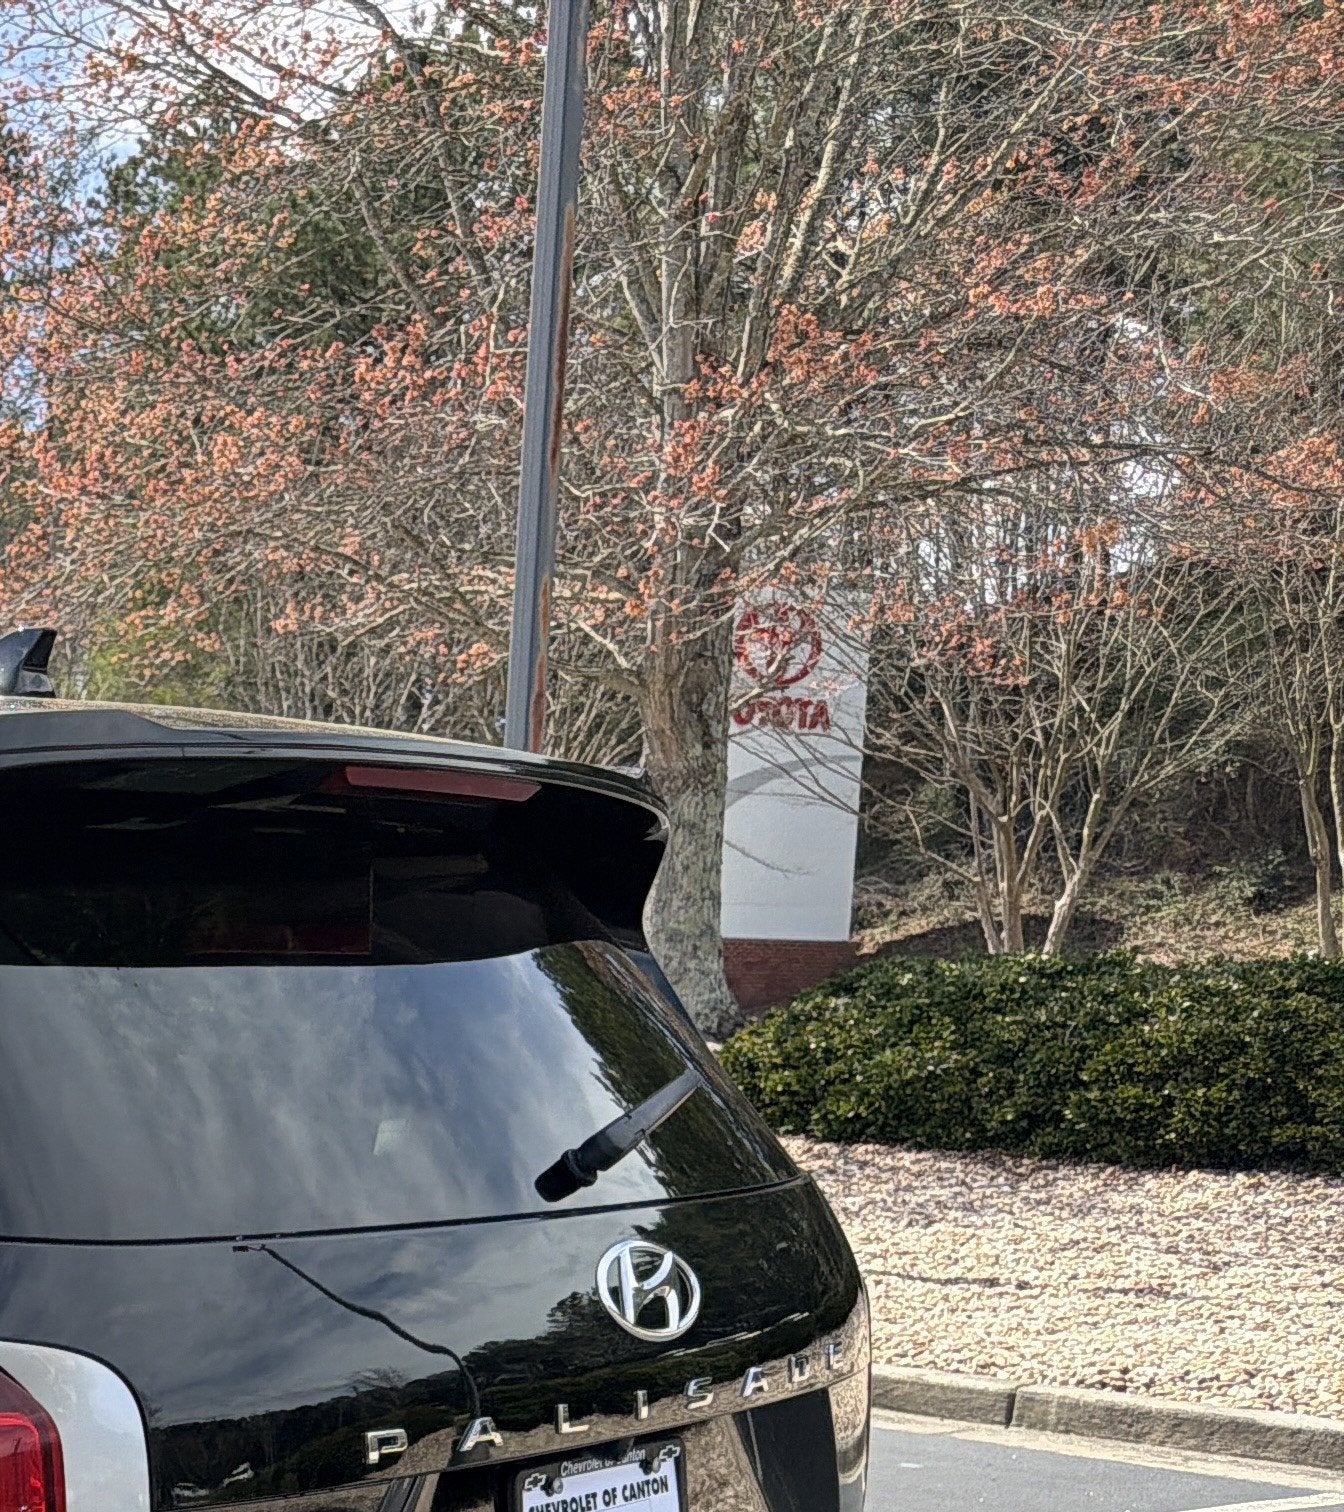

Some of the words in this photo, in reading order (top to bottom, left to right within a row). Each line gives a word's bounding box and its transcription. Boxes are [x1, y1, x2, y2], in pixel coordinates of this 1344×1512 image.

[364, 1341, 845, 1465] PALISADE
[601, 1486, 618, 1508] OF
[621, 1475, 670, 1502] CANTON
